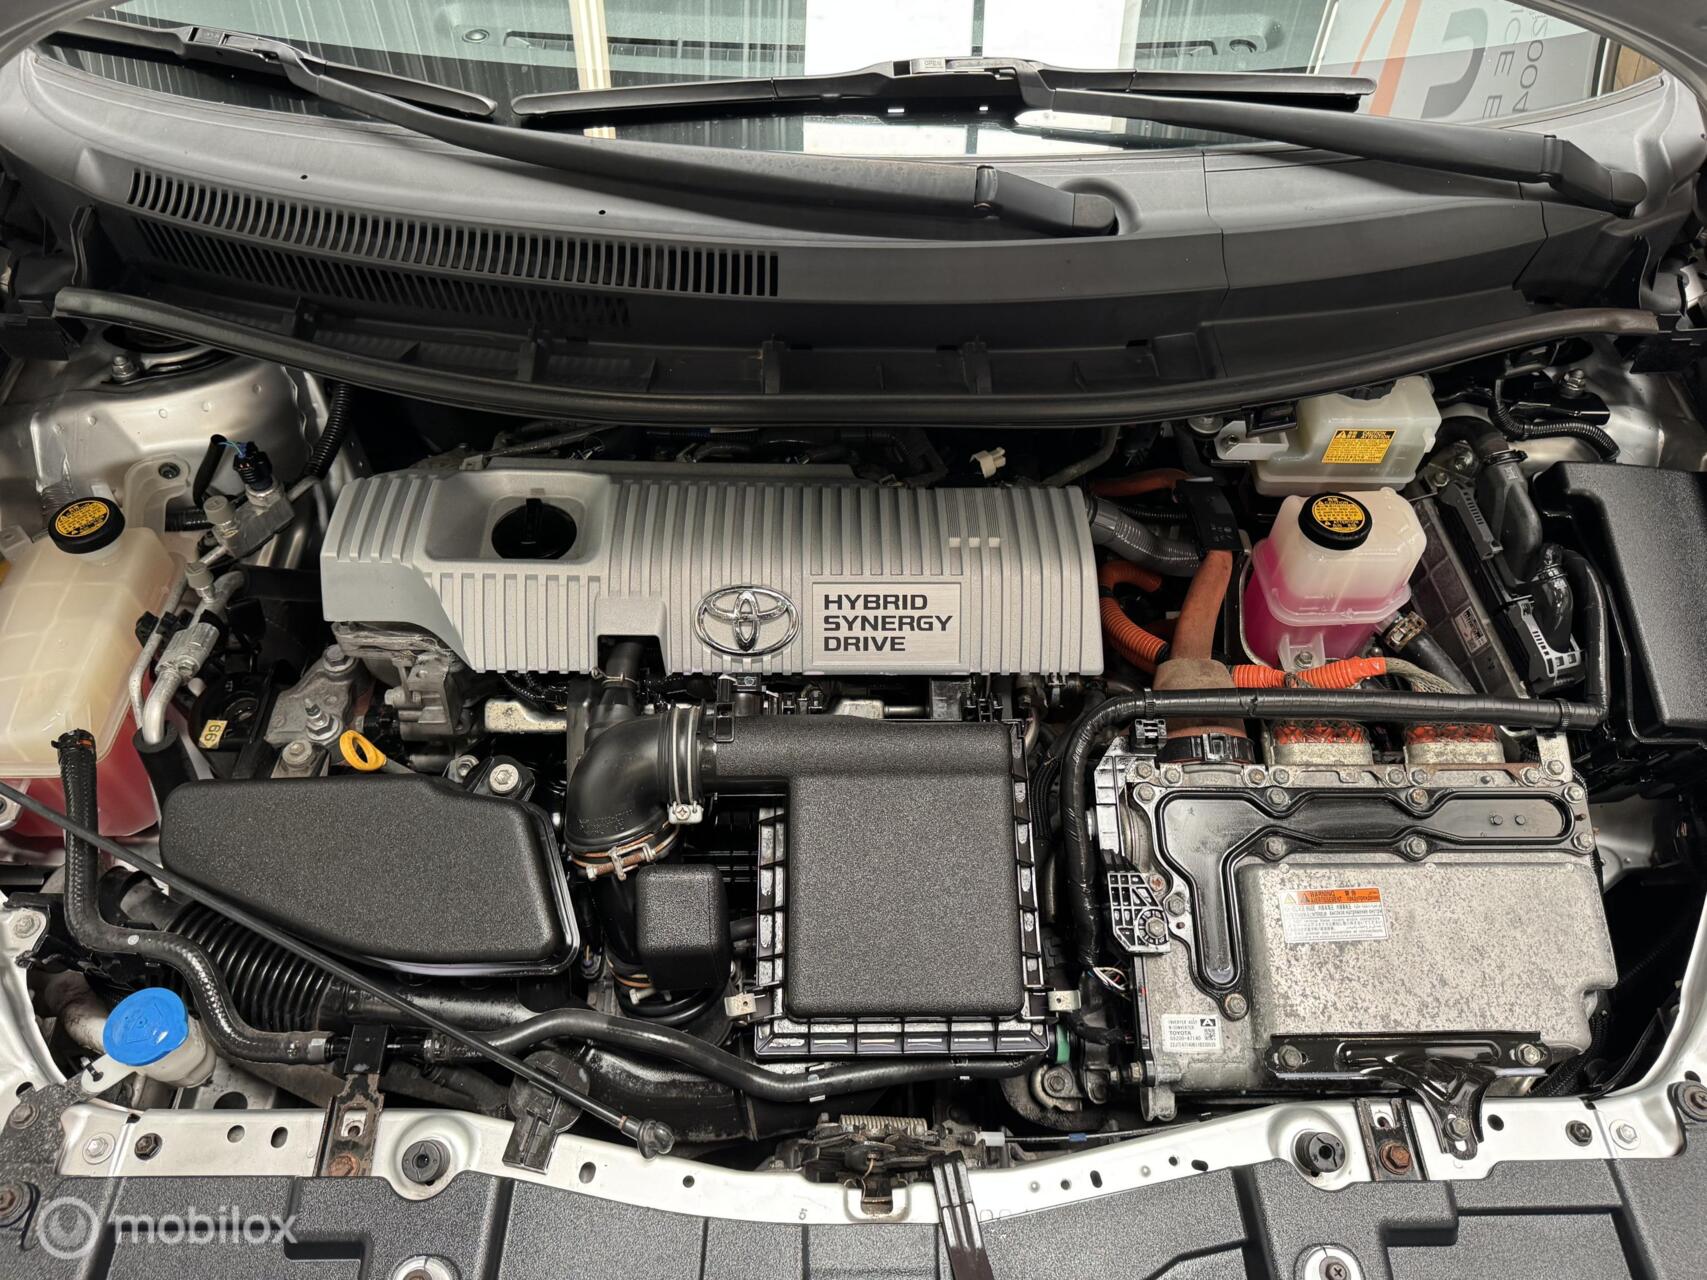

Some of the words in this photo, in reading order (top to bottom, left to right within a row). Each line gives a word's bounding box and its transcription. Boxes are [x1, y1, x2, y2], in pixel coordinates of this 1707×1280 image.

[824, 594, 928, 610] HYBRID
[824, 615, 953, 632] SYNERGY
[824, 636, 906, 652] DRIVE
